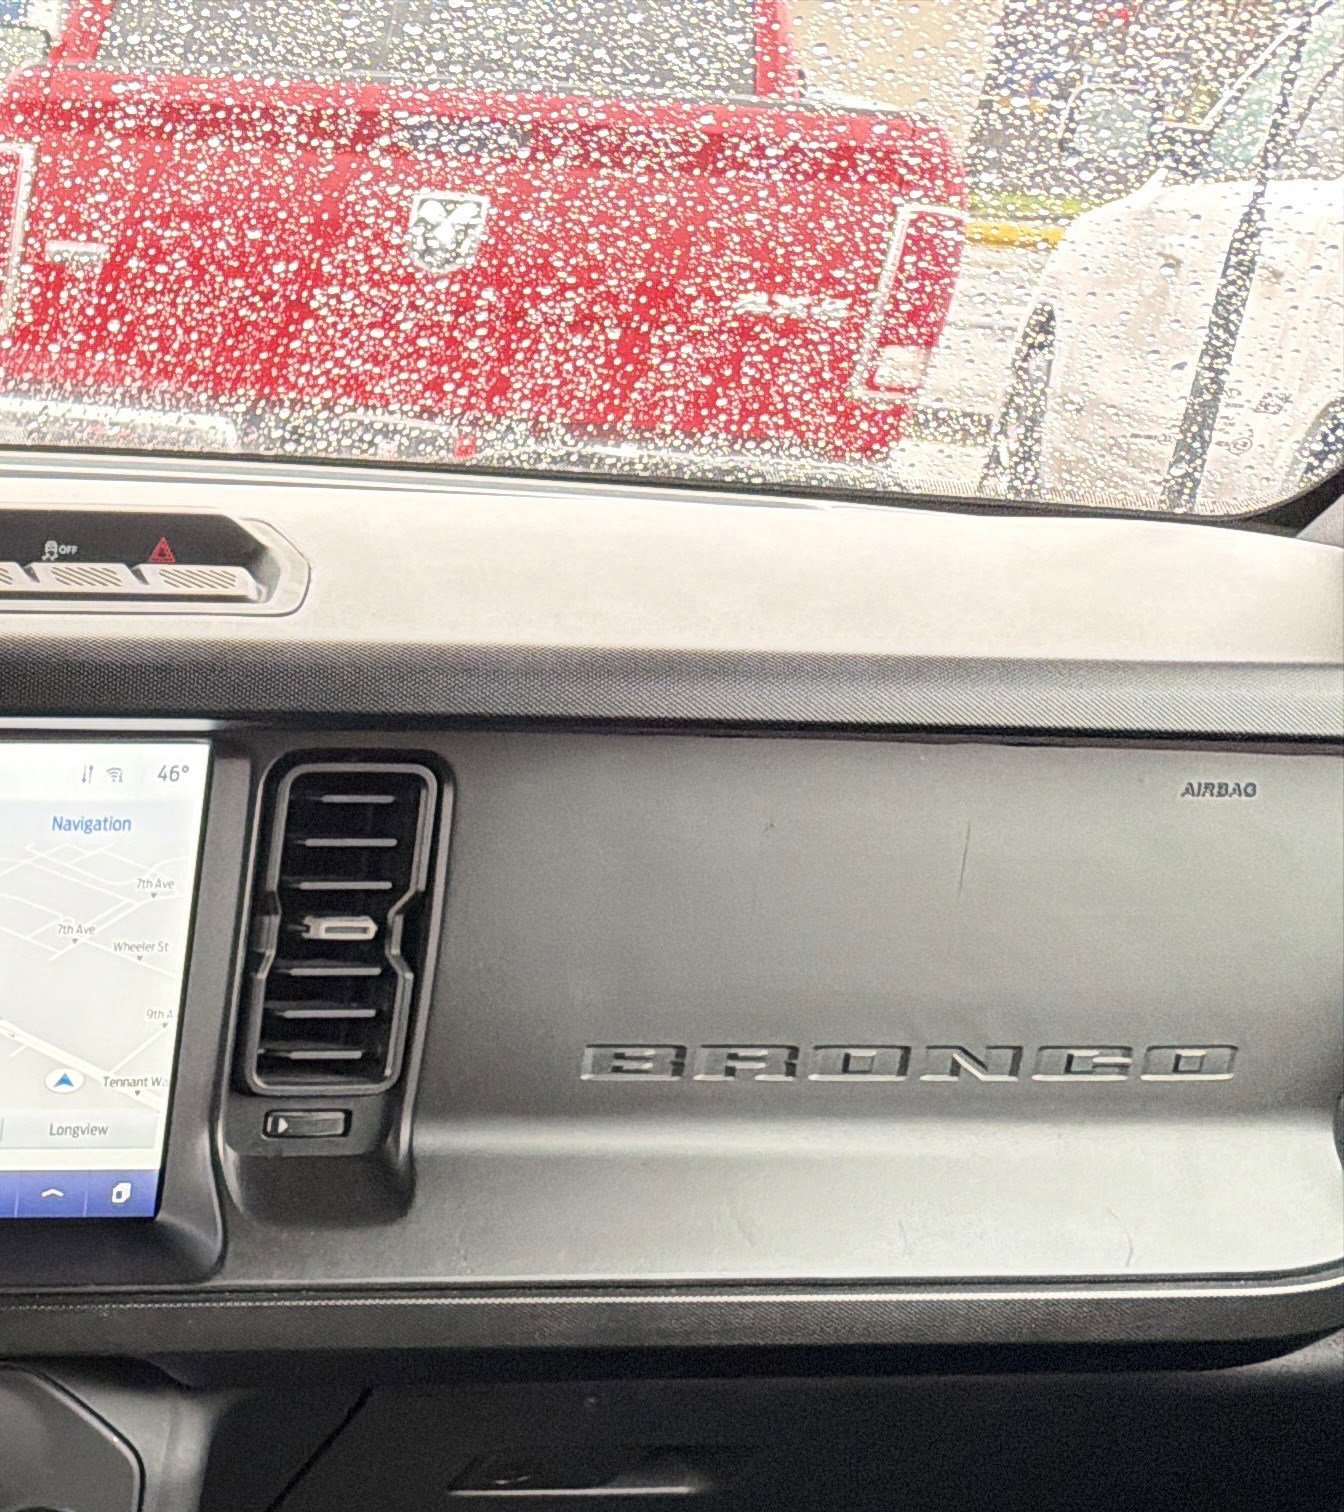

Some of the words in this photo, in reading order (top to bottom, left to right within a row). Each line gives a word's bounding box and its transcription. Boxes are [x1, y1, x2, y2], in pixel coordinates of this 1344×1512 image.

[59, 544, 78, 554] OFF
[157, 764, 190, 782] 46°
[1180, 782, 1258, 798] AIRBAG
[51, 816, 132, 834] Navigation
[136, 878, 153, 889] 7th
[155, 878, 175, 889] Ave
[57, 924, 73, 935] 7th
[76, 924, 95, 935] Ave
[113, 941, 156, 952] Wheeler
[158, 941, 169, 952] St
[580, 1043, 1239, 1082] BRONCO
[103, 1076, 149, 1088] Tennant
[49, 1123, 109, 1138] Longview
